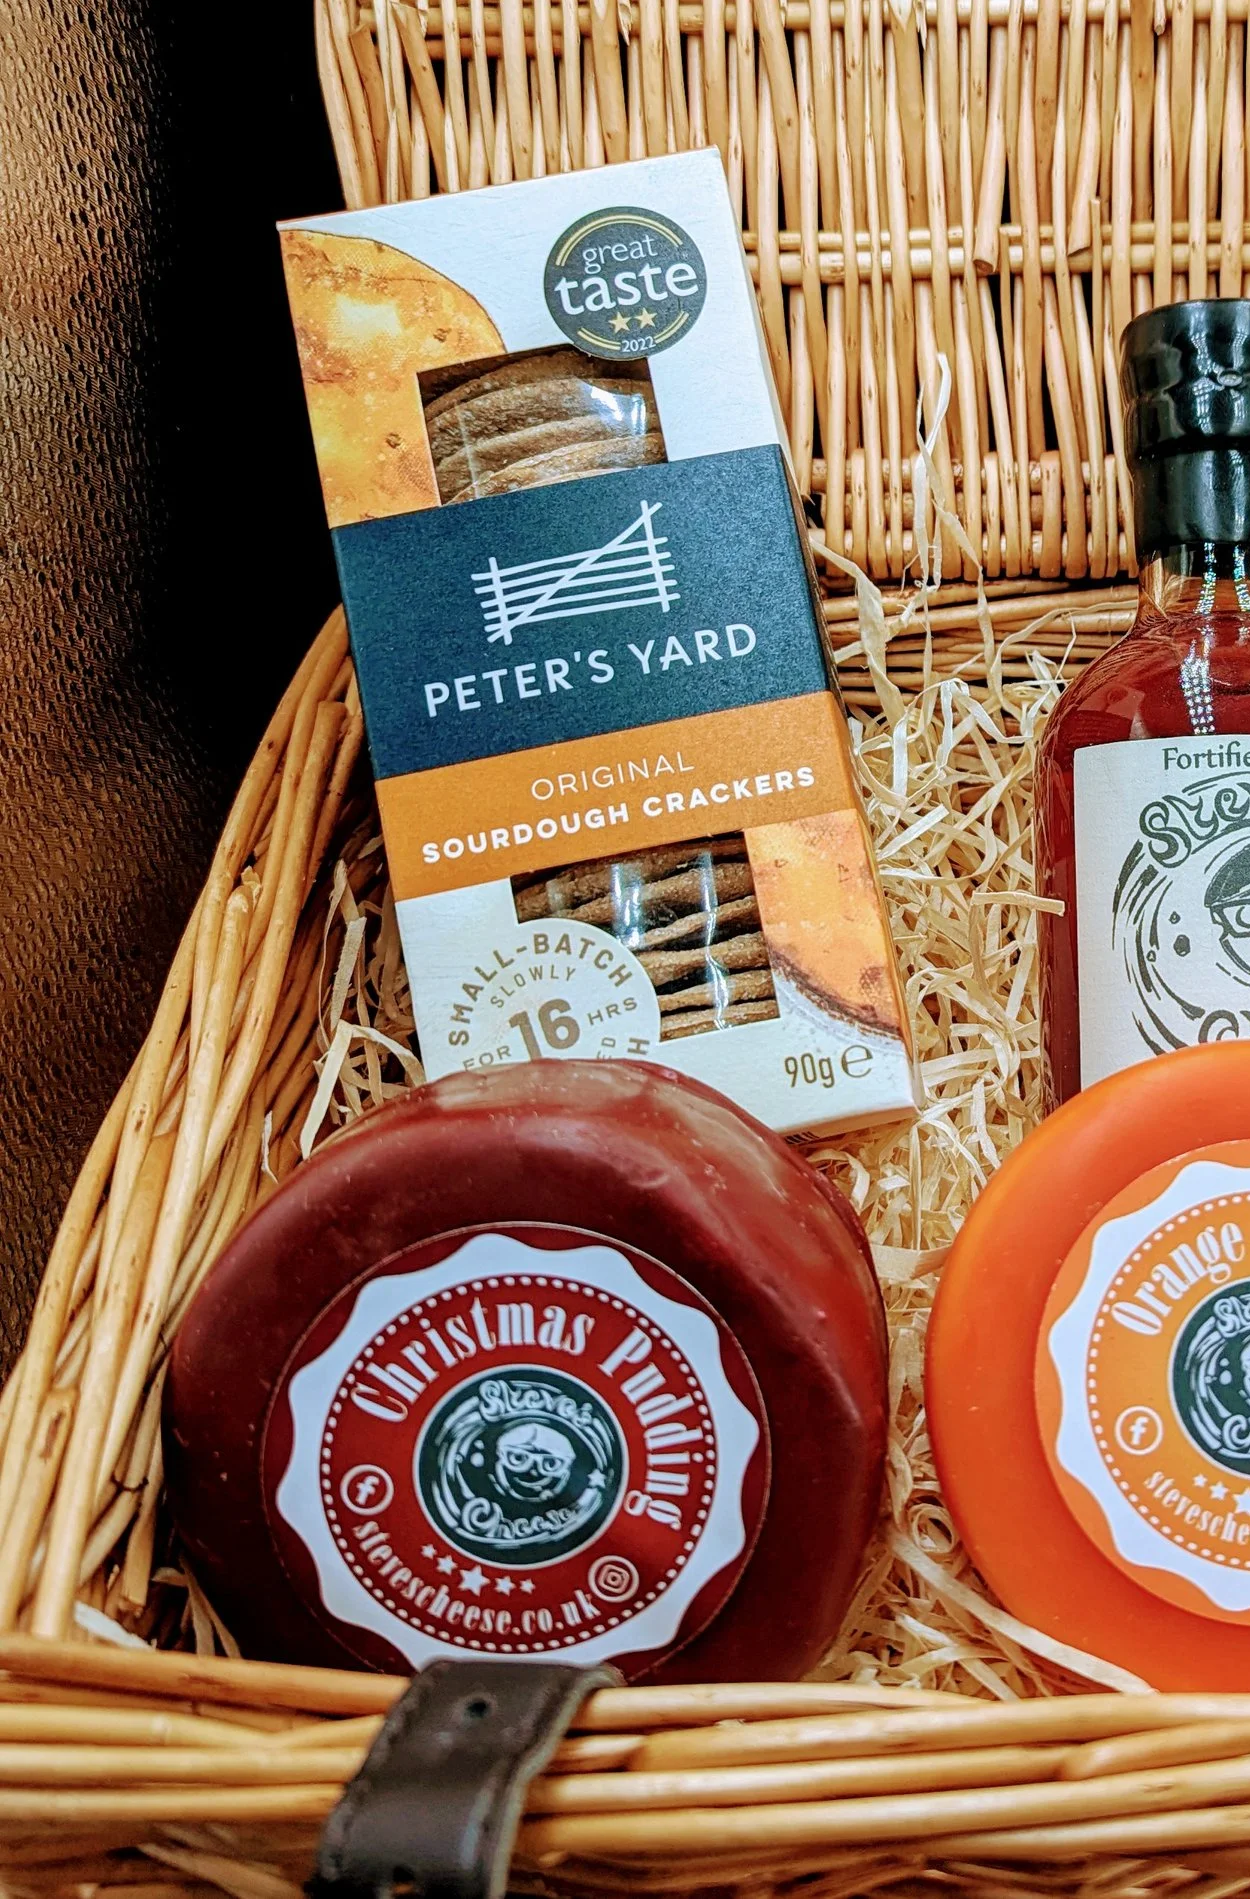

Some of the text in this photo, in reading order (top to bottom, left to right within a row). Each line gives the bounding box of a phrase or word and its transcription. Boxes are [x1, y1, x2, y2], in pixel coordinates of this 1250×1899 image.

[554, 262, 699, 316] taste
[582, 234, 658, 275] great
[622, 335, 657, 353] 2022
[424, 622, 757, 718] PETER'S YARD
[530, 751, 695, 801] ORIGINAL
[422, 766, 816, 864] SOURDOUGH CRACKERS
[448, 932, 633, 1047] SMALL-BATCH
[490, 964, 577, 1009] SLOWLY
[462, 1045, 513, 1071] FOR
[508, 998, 581, 1061] 16
[587, 997, 638, 1026] HRS
[784, 1052, 836, 1089] 90g
[1111, 1220, 1246, 1336] Orange
[351, 1296, 704, 1532] Christmas Pudding
[352, 1519, 600, 1637] stevescheese.co.uk
